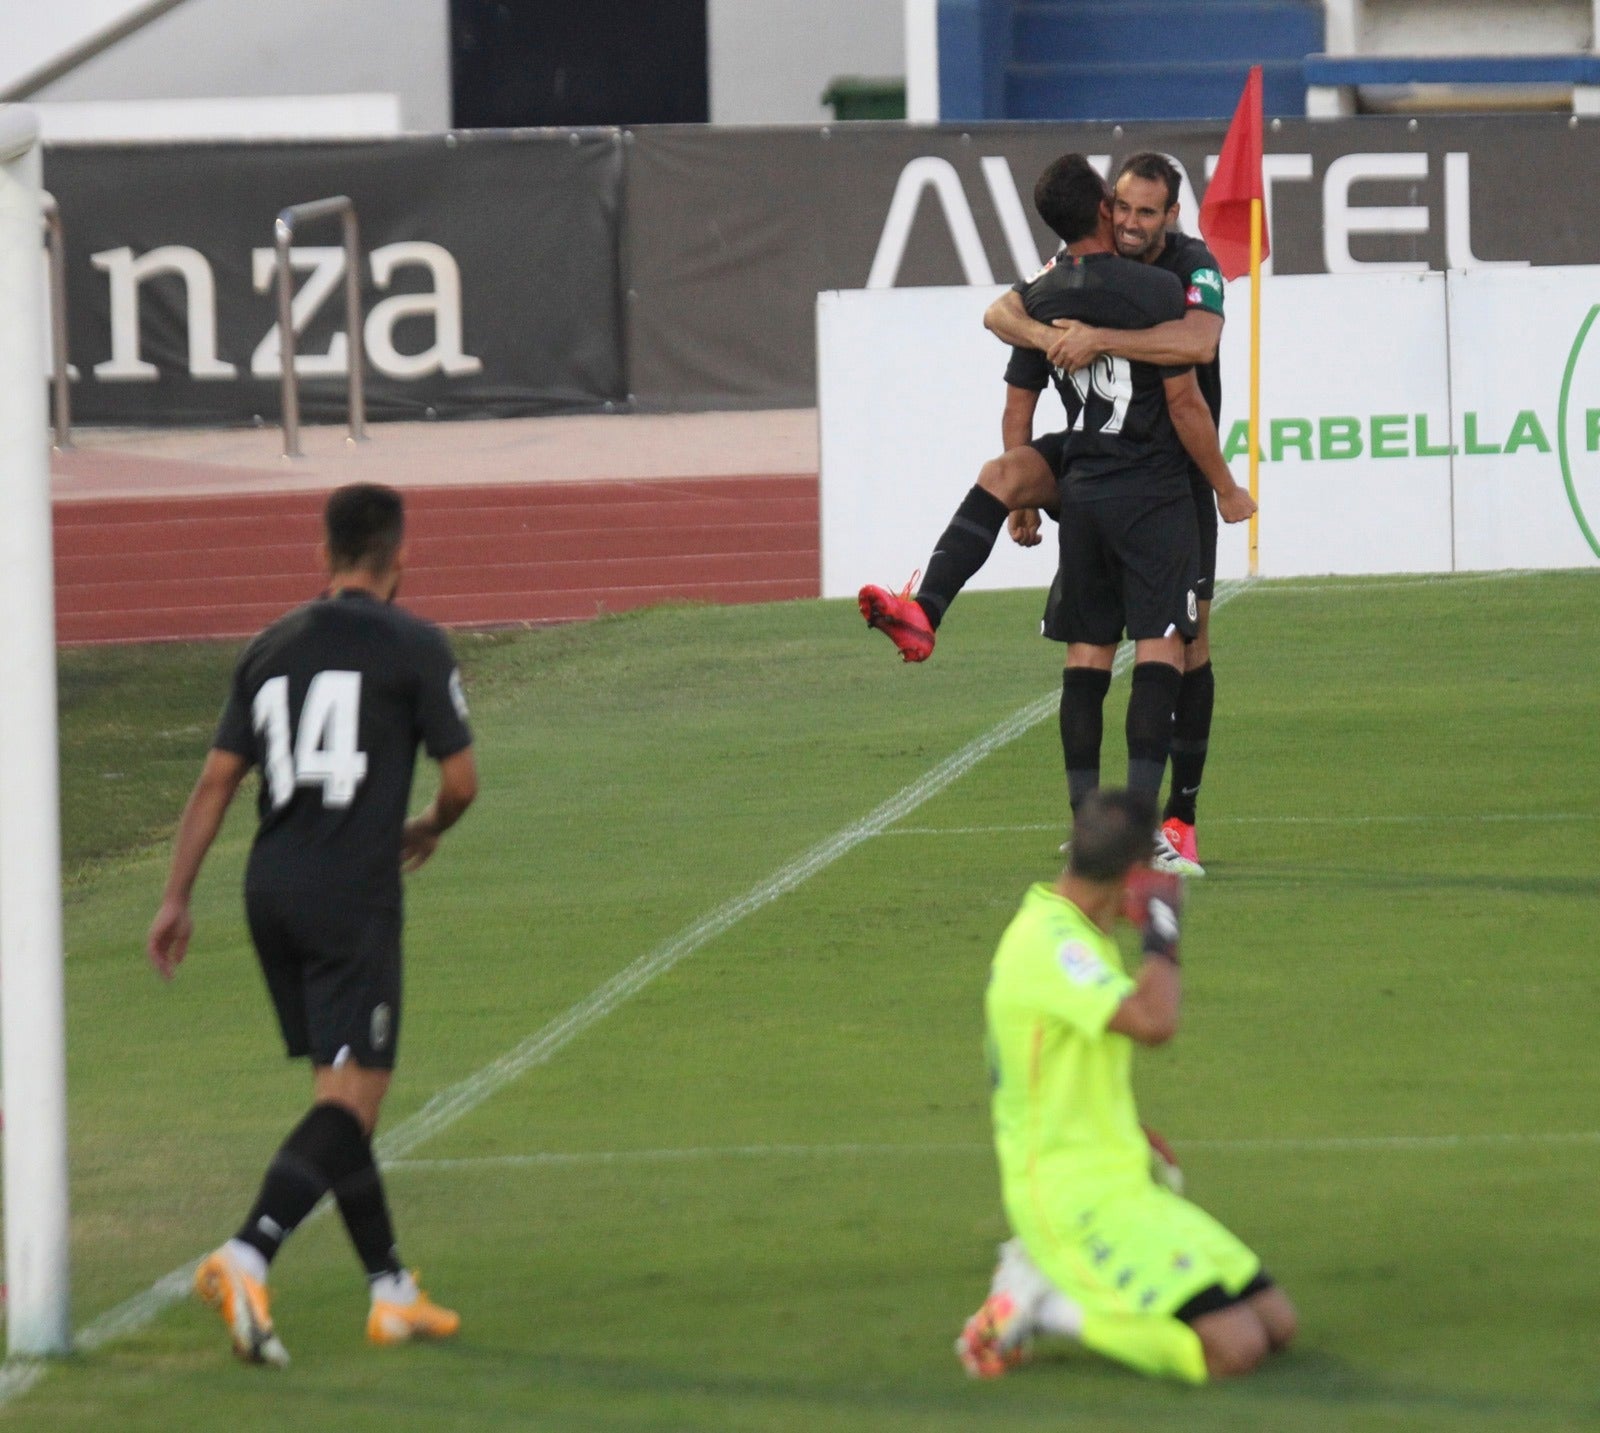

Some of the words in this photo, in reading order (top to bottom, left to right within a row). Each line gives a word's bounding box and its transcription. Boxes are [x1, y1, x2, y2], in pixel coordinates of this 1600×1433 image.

[47, 241, 483, 379] nza
[1222, 410, 1553, 463] ARBELLA
[252, 669, 368, 810] 14
